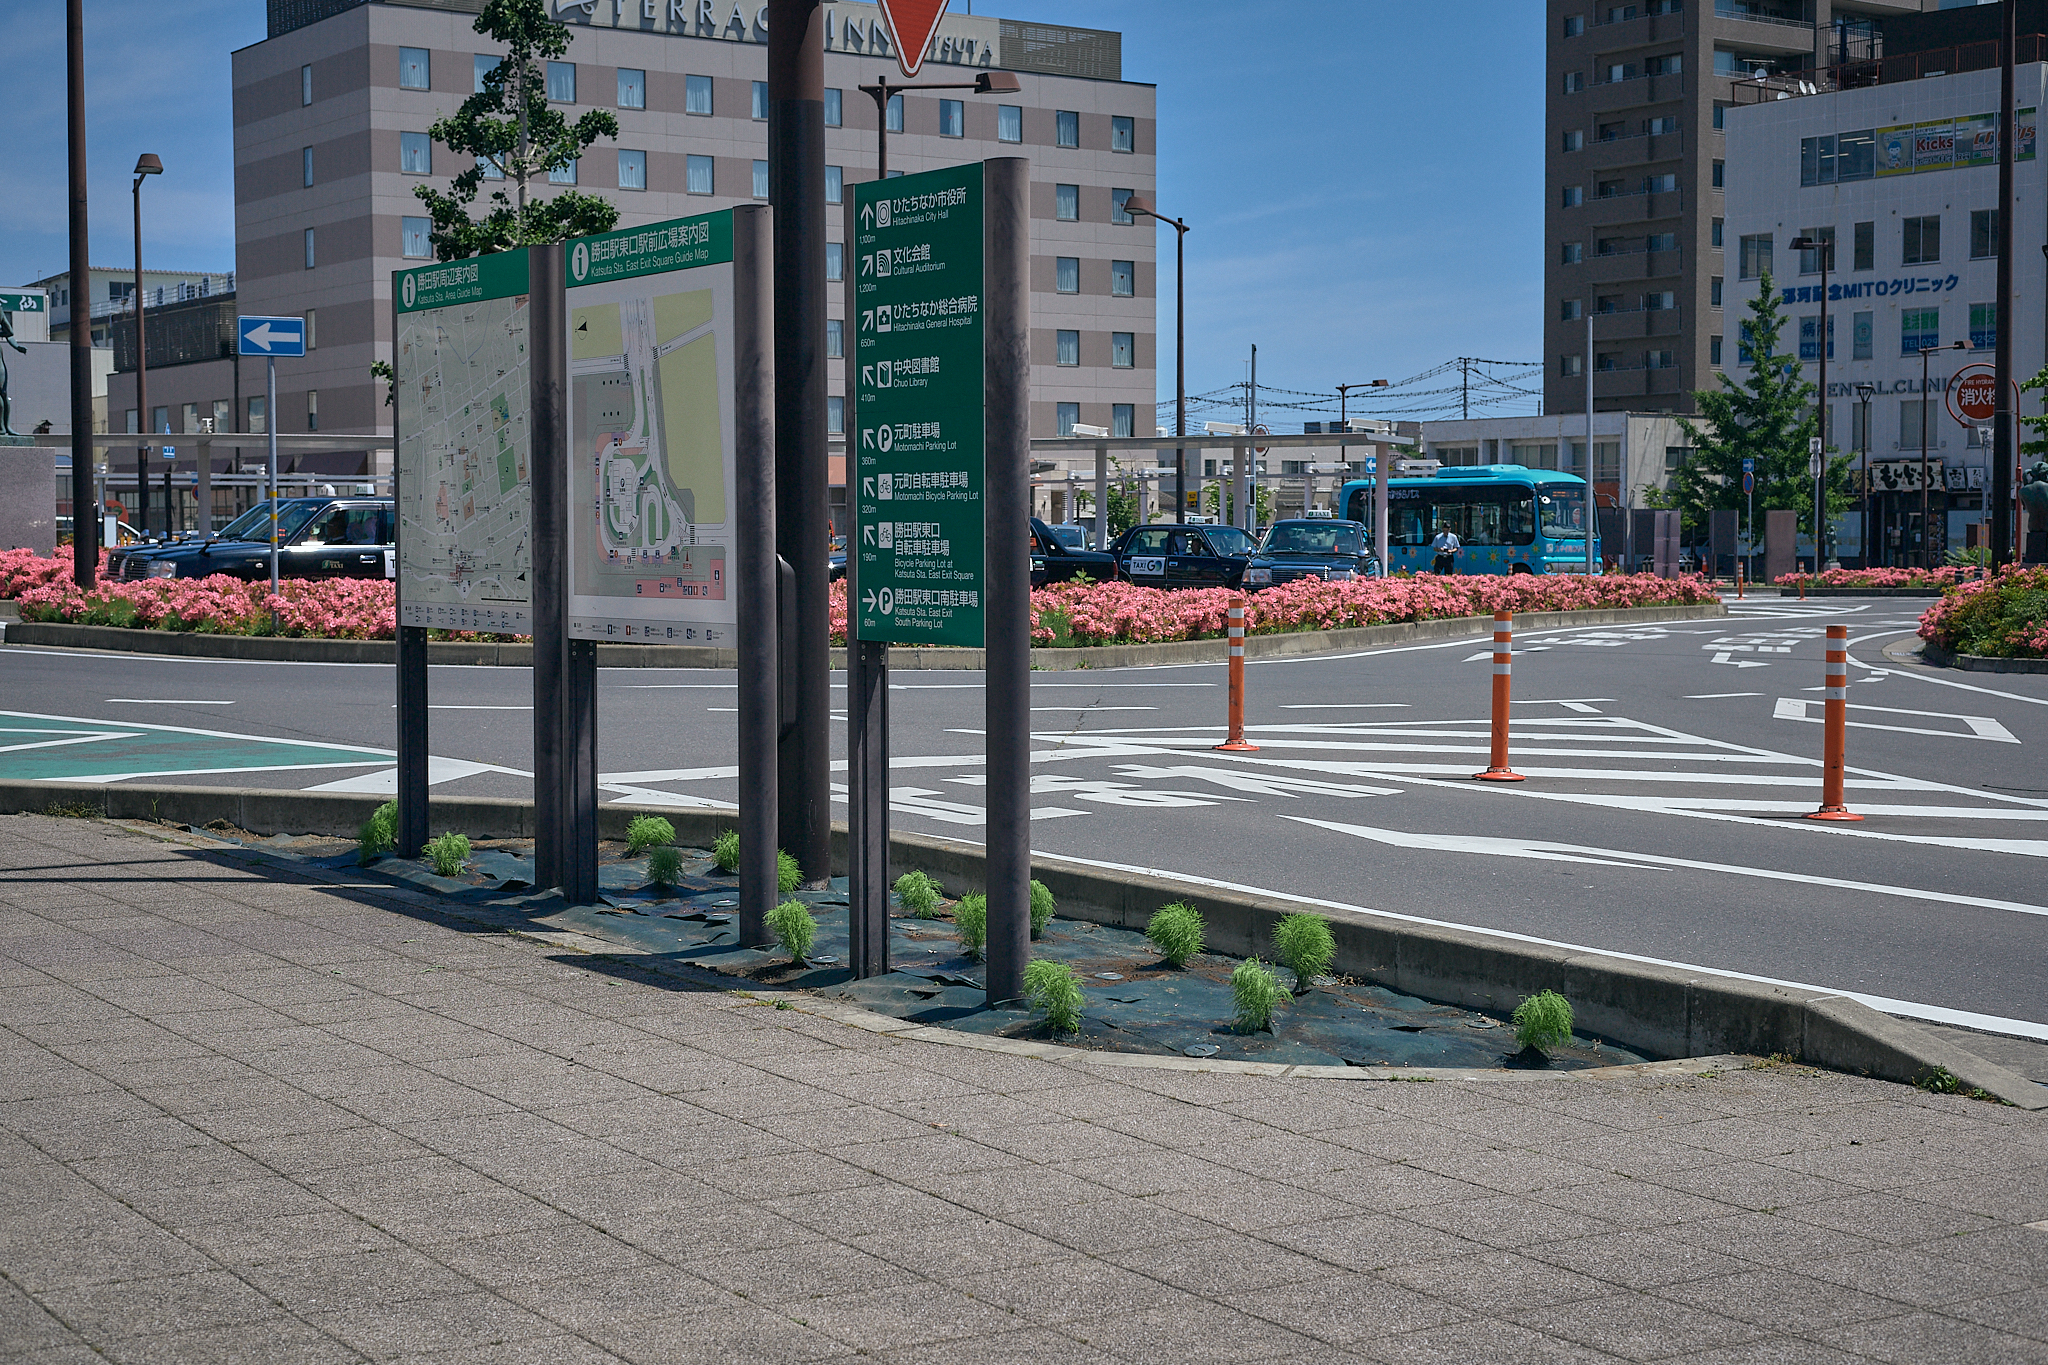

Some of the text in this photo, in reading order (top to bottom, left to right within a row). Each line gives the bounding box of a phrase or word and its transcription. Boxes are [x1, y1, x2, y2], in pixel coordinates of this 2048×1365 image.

[612, 0, 768, 31] ERRAC
[933, 35, 993, 56] TSUTA
[1916, 136, 1953, 151] Kicks
[893, 186, 966, 214] ひたちなか市役所
[892, 209, 949, 226] Hitachinaka City Hall
[590, 222, 709, 262] 勝田駅東口駅前広場案内図
[894, 243, 931, 265] 文化会館
[591, 248, 709, 277] Katsuta Sta. East Exit Square Guide Map
[894, 261, 946, 276] Cultural Auditorium
[418, 264, 478, 292] 勝田駅周辺案内図
[418, 286, 482, 305] Katsuta Sta. Area Guide Map
[859, 283, 877, 294] 1,200m
[894, 295, 978, 319] ひたちなか総合病院
[894, 316, 972, 332] Hitachinaka General Hospital
[860, 338, 876, 348] 650m
[894, 356, 940, 376] 中央図書館
[894, 378, 928, 388] Chuo Library
[861, 394, 876, 402] 410m
[894, 422, 940, 440] 元町駐車場
[894, 441, 957, 452] Motomachi Parking Lot
[862, 456, 876, 466] 360m
[894, 471, 968, 490] 元町自転車駐車場
[894, 490, 979, 502] Motomachi Bicycle Parking Lot
[862, 505, 876, 514] 320m
[894, 522, 940, 539] 勝田駅東口
[895, 540, 950, 556] 自転車駐車場
[863, 553, 876, 562] 190m
[894, 559, 953, 570] Bicycle Parking Lot at
[895, 570, 974, 581] Katsuta Sta. East Exit Square
[894, 588, 978, 608] 勝田駅東口南駐車場
[895, 607, 953, 618] Katsuta Sta. East Exit
[864, 619, 875, 627] 60m
[895, 618, 943, 629] South Parking Lot
